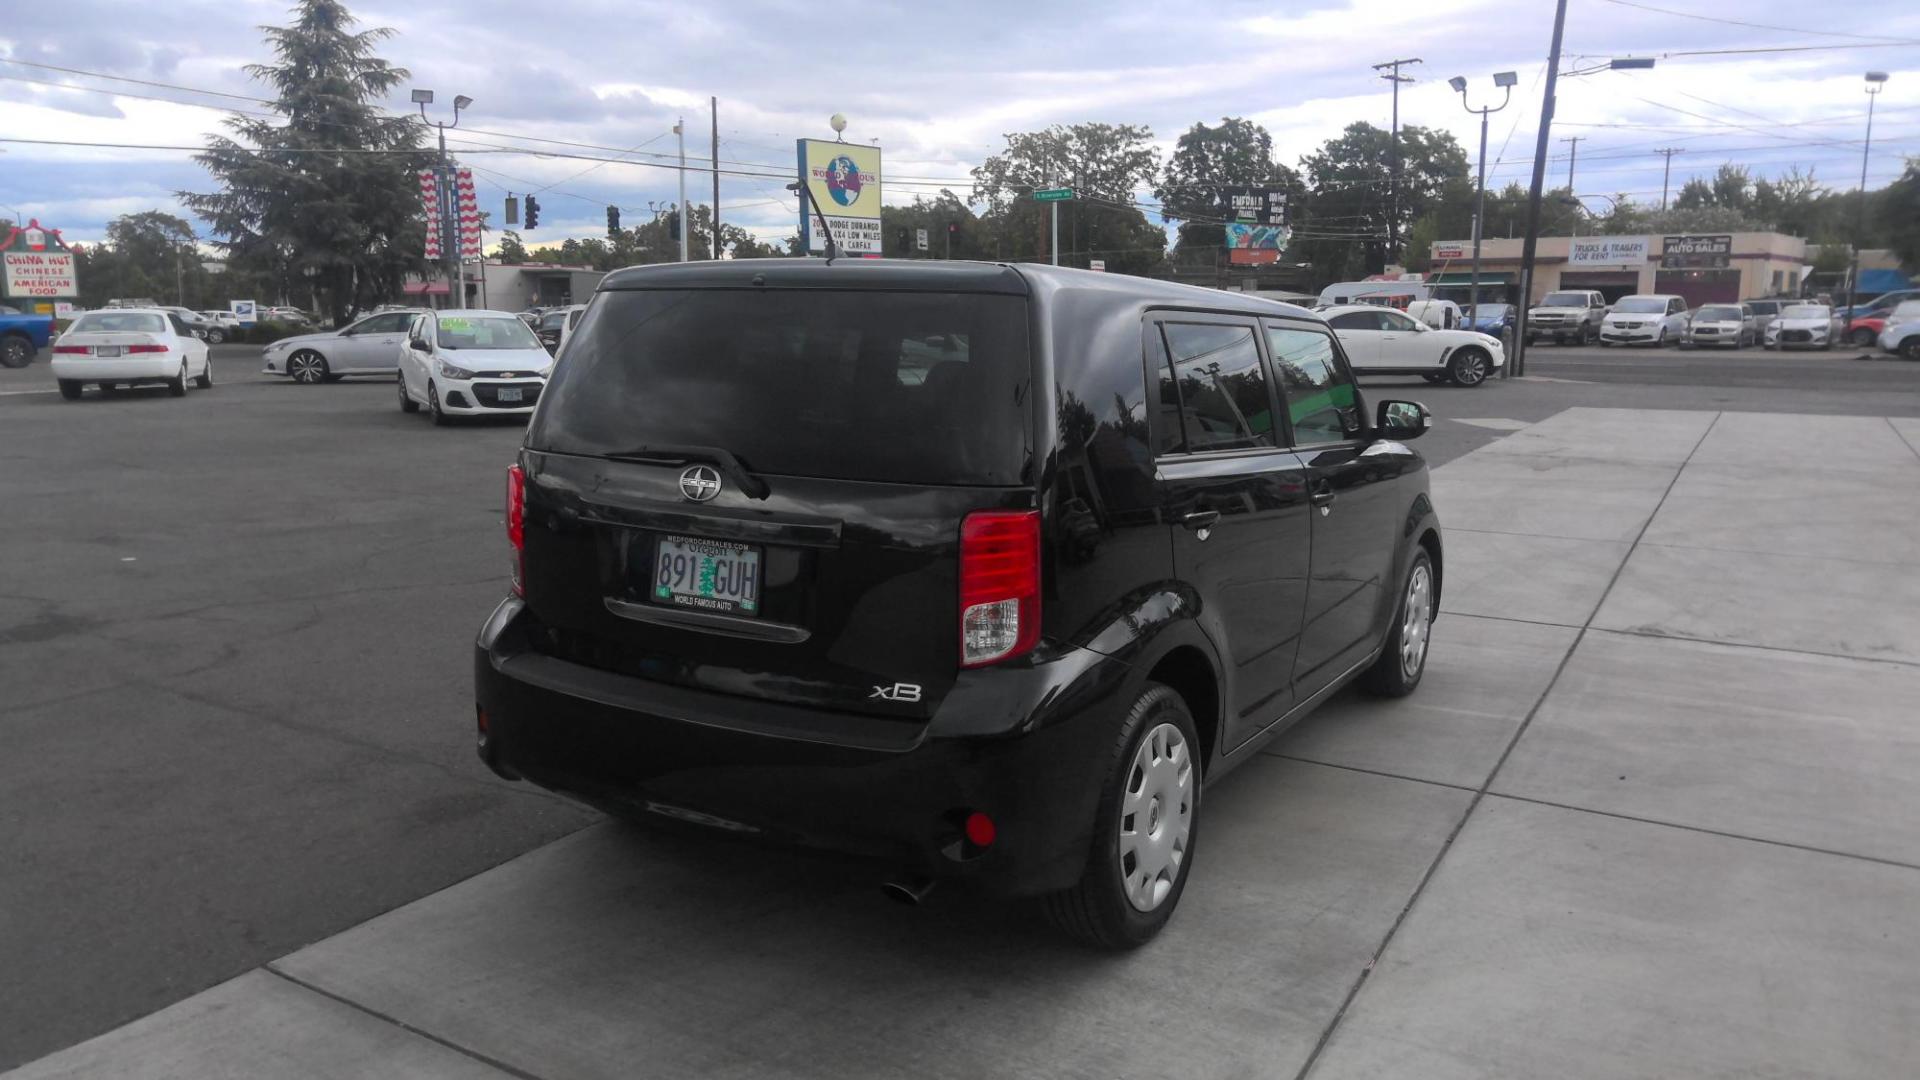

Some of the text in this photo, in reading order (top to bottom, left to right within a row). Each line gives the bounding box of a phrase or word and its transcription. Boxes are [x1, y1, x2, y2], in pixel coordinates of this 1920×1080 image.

[1231, 195, 1263, 206] EMERALD
[830, 220, 849, 229] DODGE
[851, 221, 879, 231] DURANGO
[833, 230, 845, 239] 4X4
[847, 231, 860, 239] LOW
[863, 231, 880, 240] MILES
[848, 241, 871, 250] CARFAX
[1575, 244, 1600, 252] TRUCKS
[1611, 243, 1642, 252] TRAILERS
[1667, 243, 1726, 254] AUTO SALES
[6, 254, 70, 265] CHINA HUT
[1574, 252, 1588, 260] FOR
[1591, 252, 1609, 260] RENT
[16, 267, 64, 275] CHINESE
[14, 279, 70, 287] AMERICAN
[29, 287, 57, 295] FOOD
[667, 535, 749, 551] MEDFORDCARSALES.COM
[689, 542, 728, 557] Oregon
[659, 552, 756, 599] 891 GUH
[674, 594, 693, 605] WORLD
[694, 597, 716, 609] FAMOUS
[717, 600, 732, 611] AUTO
[868, 682, 922, 702] xB
